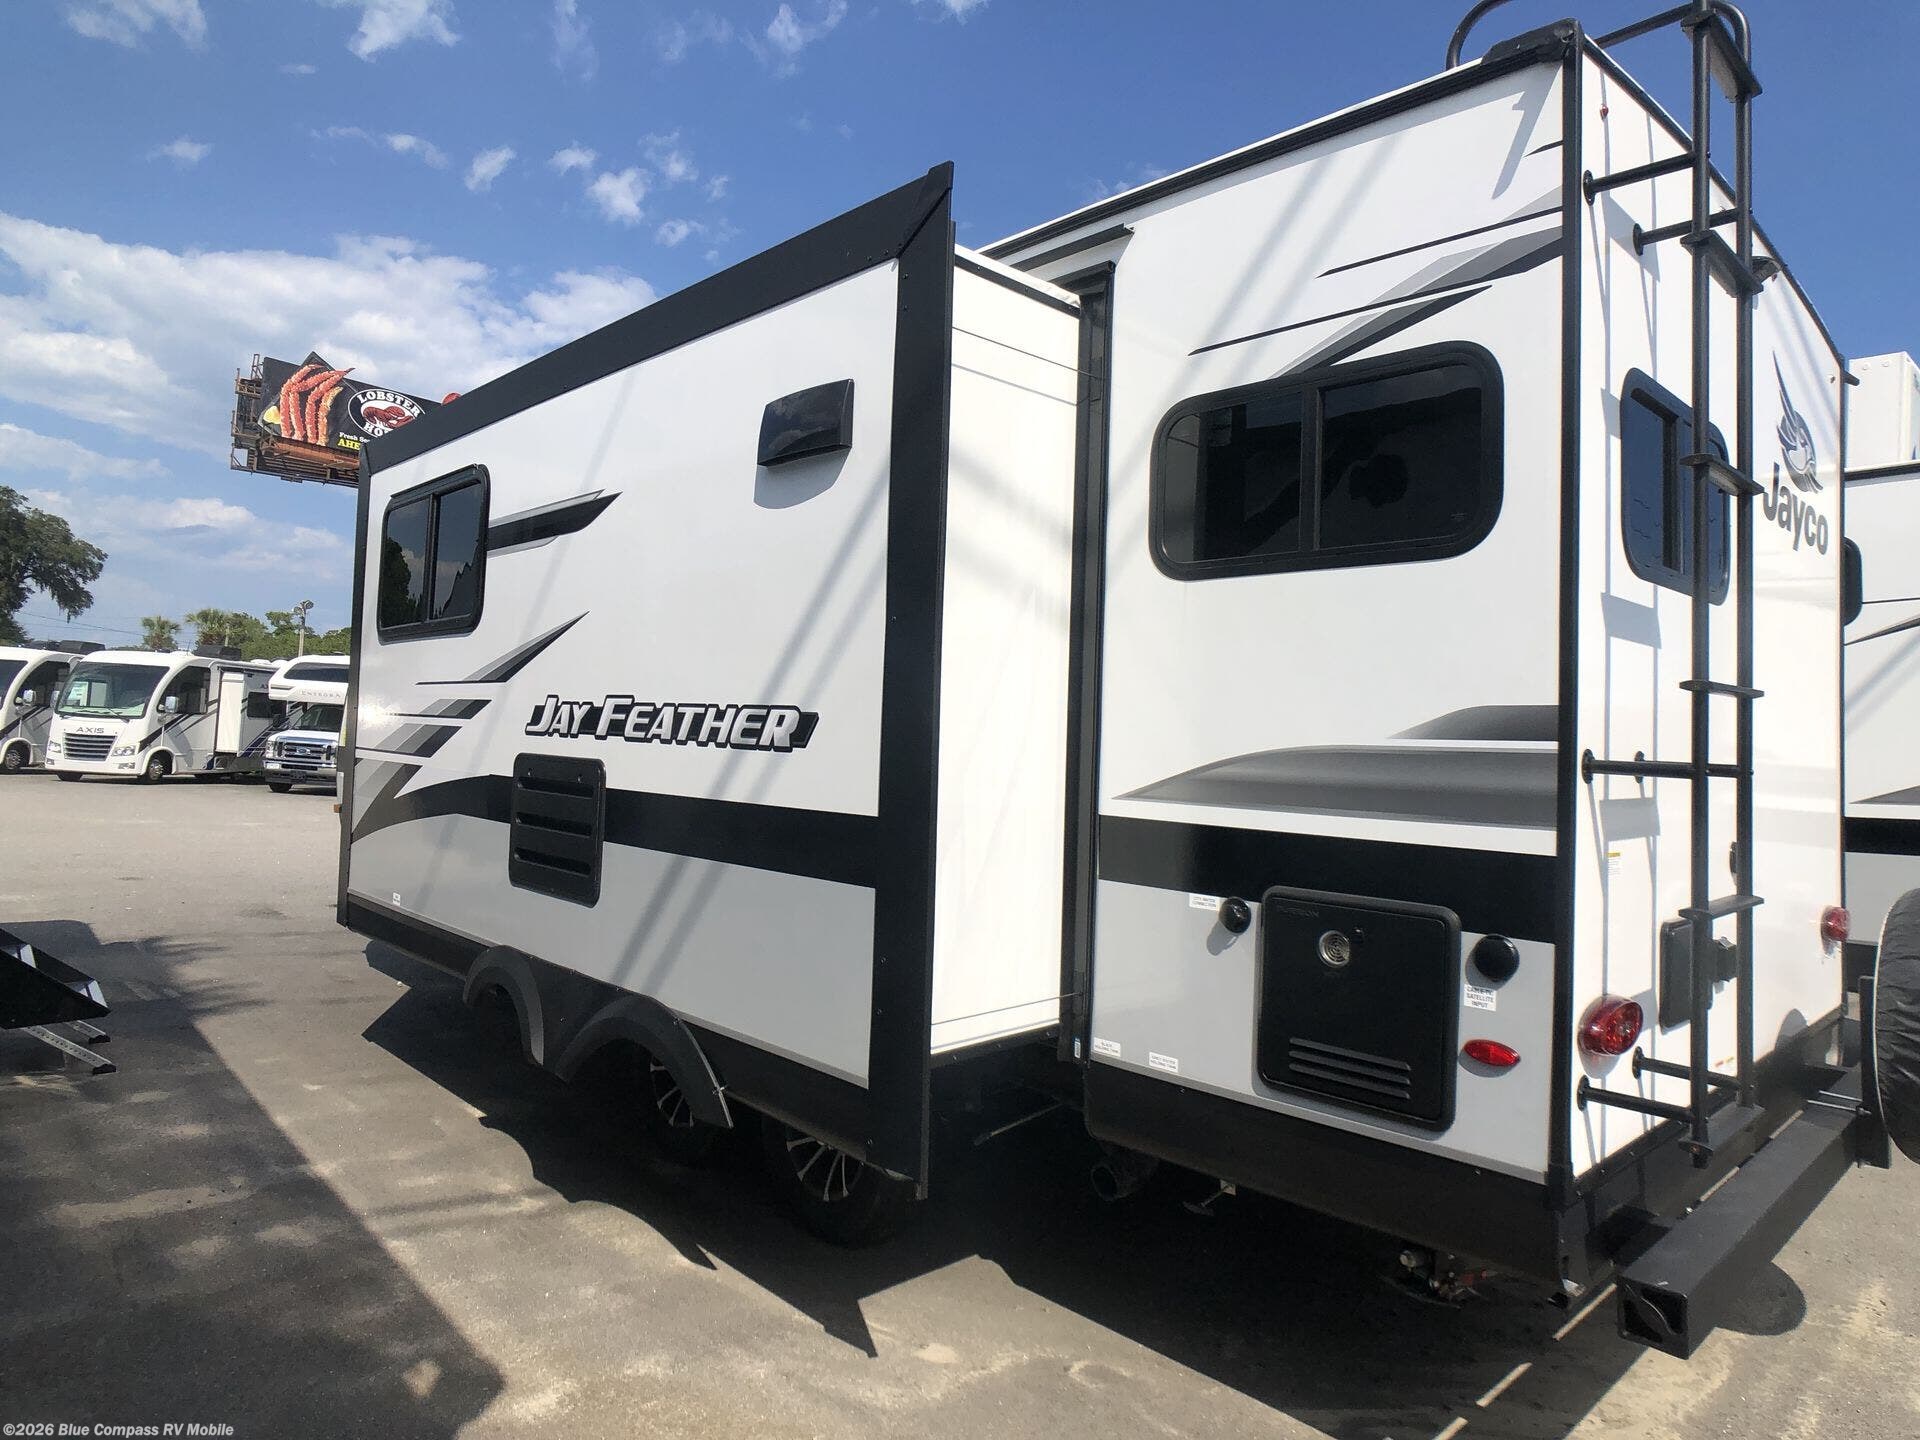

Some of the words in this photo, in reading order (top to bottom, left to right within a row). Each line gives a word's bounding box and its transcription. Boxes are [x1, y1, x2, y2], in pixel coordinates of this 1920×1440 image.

[357, 391, 420, 417] LOBSTER
[339, 432, 358, 441] Fresh
[1763, 462, 1828, 555] Jayco
[76, 726, 105, 734] AXIS
[525, 695, 594, 738] JAY
[594, 695, 801, 753] FEATHER
[1467, 993, 1494, 1003] SATELLITE
